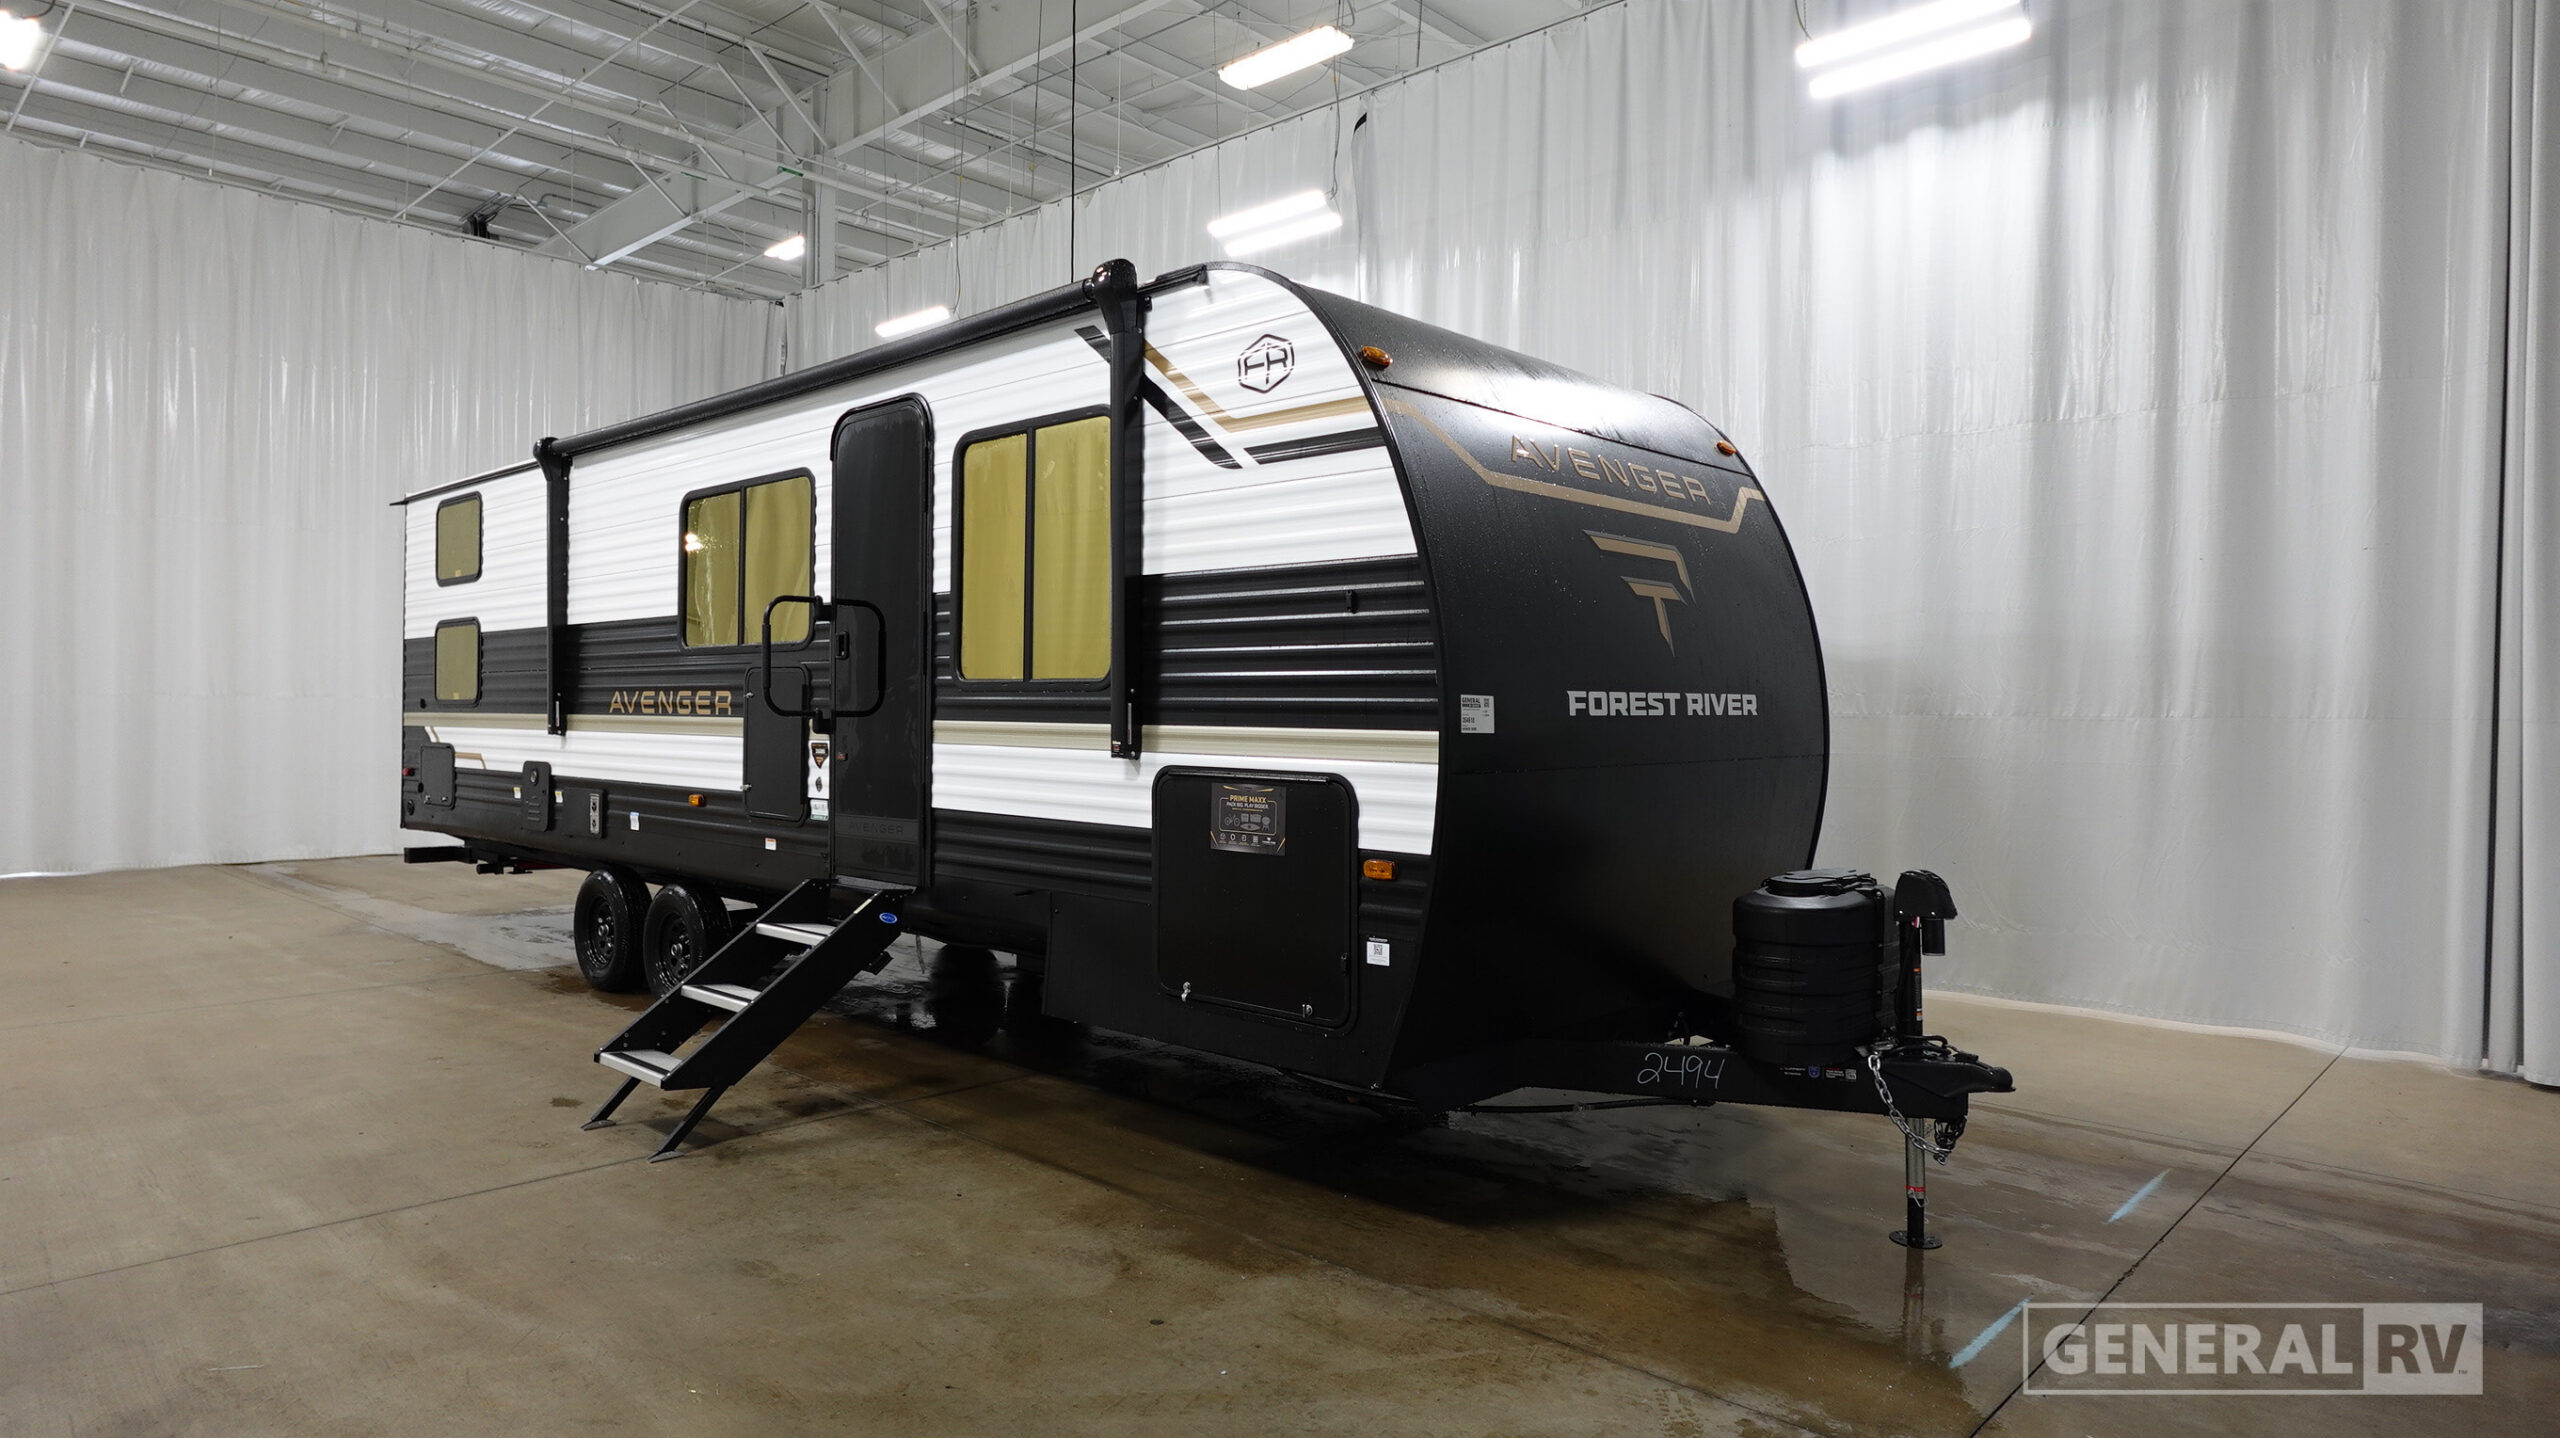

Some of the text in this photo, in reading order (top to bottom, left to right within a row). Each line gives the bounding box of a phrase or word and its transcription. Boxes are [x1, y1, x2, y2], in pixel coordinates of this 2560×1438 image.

[1510, 433, 1712, 505] AVENGER
[608, 690, 733, 716] AVENGER
[1566, 690, 1759, 717] FOREST RIVER
[1230, 794, 1248, 802] PRIME
[847, 822, 905, 836] AVENGER
[1637, 1051, 1726, 1089] 2494
